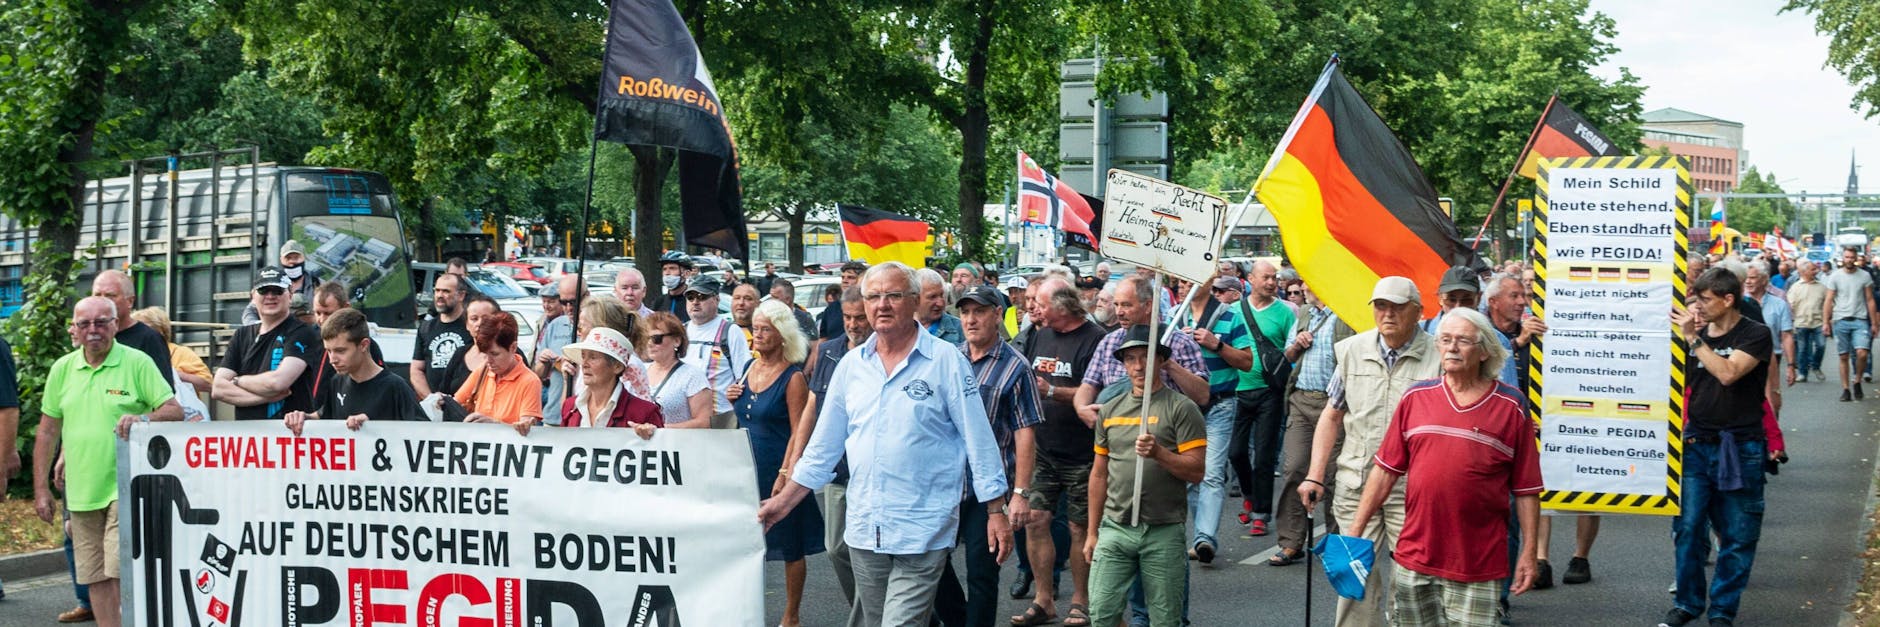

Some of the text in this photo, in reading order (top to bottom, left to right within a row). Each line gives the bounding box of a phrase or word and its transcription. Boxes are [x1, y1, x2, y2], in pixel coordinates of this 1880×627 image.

[618, 75, 718, 116] Roßwein
[1574, 122, 1609, 156] PEGIDA
[1563, 177, 1661, 189] Mein Schild
[1172, 187, 1206, 213] Recht
[1549, 200, 1673, 212] heute stehend.
[1119, 205, 1163, 231] Heimat
[1549, 221, 1672, 235] Eben standhaft
[1144, 229, 1187, 256] Kultur
[1556, 246, 1662, 260] wie PEGIDA!
[1553, 288, 1648, 299] Wer jetzt nichts
[1553, 310, 1633, 323] begriffen hat,
[1552, 329, 1597, 338] braucht
[1551, 349, 1651, 360] auch nicht mehr
[1031, 356, 1072, 375] PEGDA
[1550, 365, 1637, 377] demonstrieren
[1558, 424, 1656, 439] Danke PEGIDA
[1544, 443, 1665, 459] für die lieben Grüße
[185, 436, 683, 486] GEWALTFREI & VEREINT GEGEN
[286, 483, 509, 515] GLAUBENSKRIEGE
[238, 521, 677, 574] AUF DEUTSCHEM BODEN!
